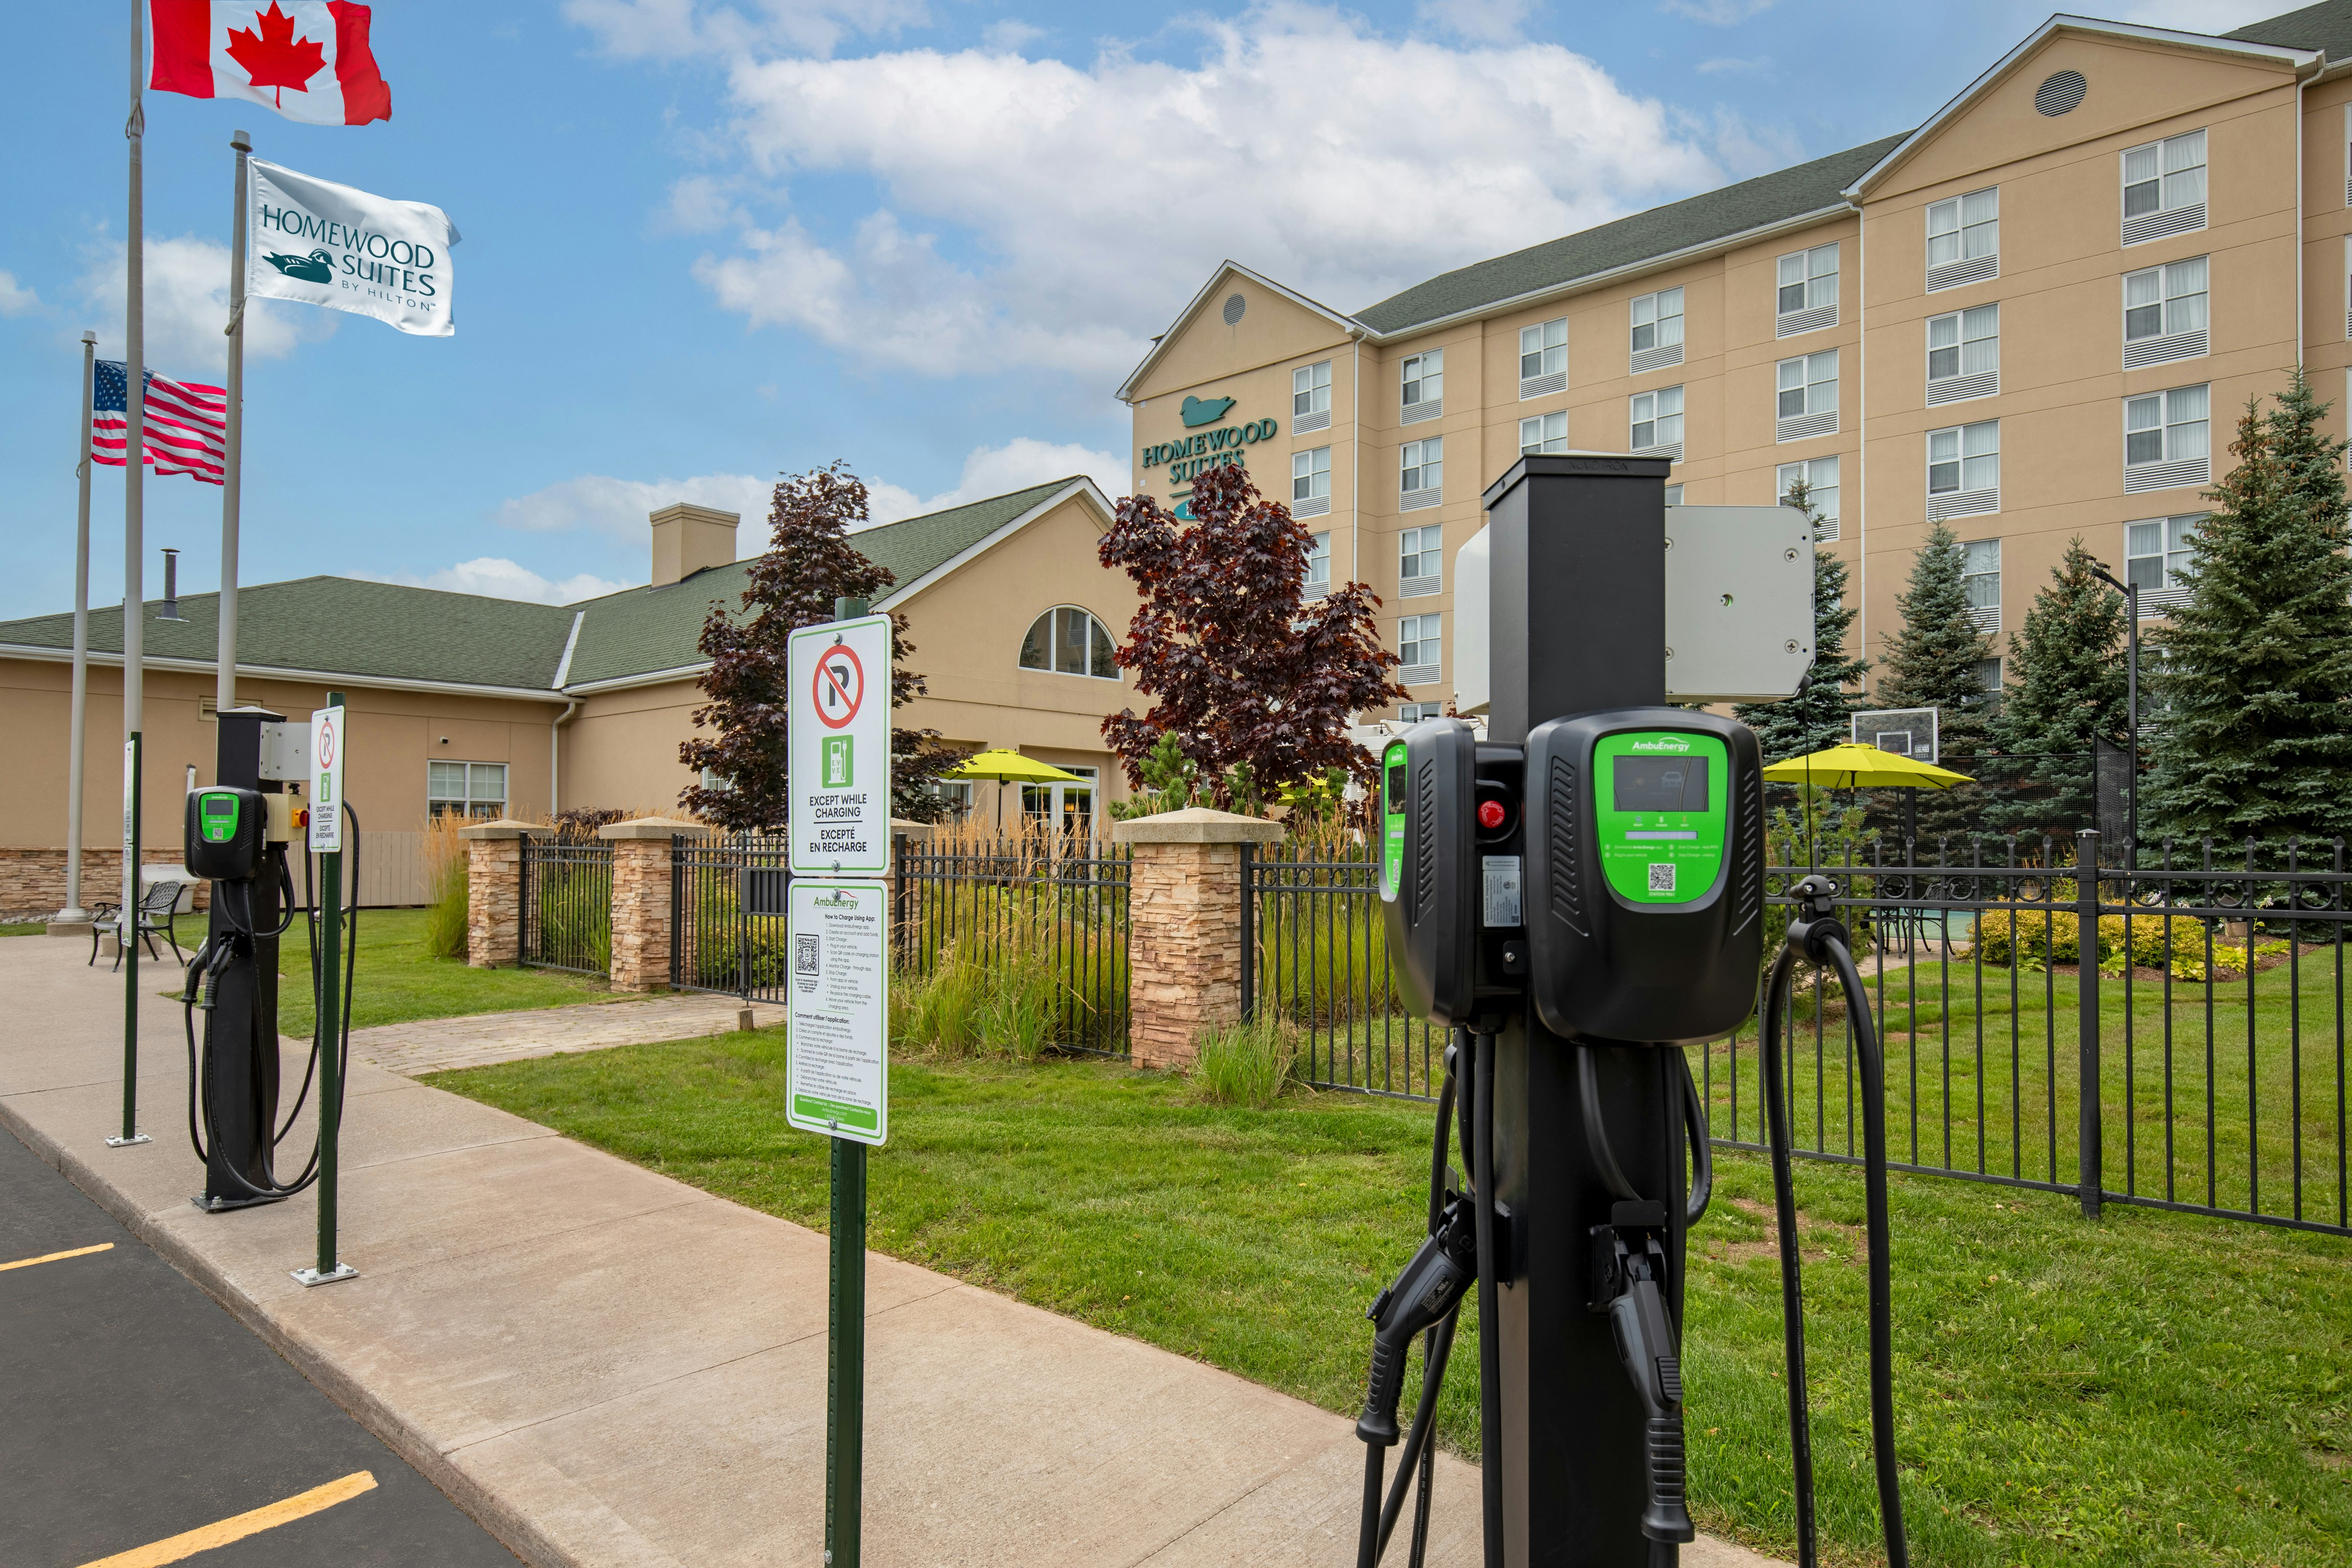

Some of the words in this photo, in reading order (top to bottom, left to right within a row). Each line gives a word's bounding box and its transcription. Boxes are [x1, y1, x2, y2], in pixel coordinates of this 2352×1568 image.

[263, 204, 434, 269] HOMEWOOD
[342, 255, 435, 296] SUITES
[342, 280, 358, 291] BY
[1142, 418, 1277, 468] HOMEWOOD
[1169, 448, 1244, 484] SUITES
[1632, 741, 1690, 752] AmbuEnergy
[810, 796, 839, 806] EXCEPT
[841, 793, 867, 804] WHILE
[816, 806, 861, 818] CHARGING
[821, 827, 855, 840] EXCEPTÉ
[810, 842, 820, 852] EN
[823, 842, 867, 852] RECHARGE
[814, 897, 858, 910] AmbuEnergy
[826, 1016, 850, 1024] l'application:
[822, 1107, 847, 1116] AmbuEnergy.com
